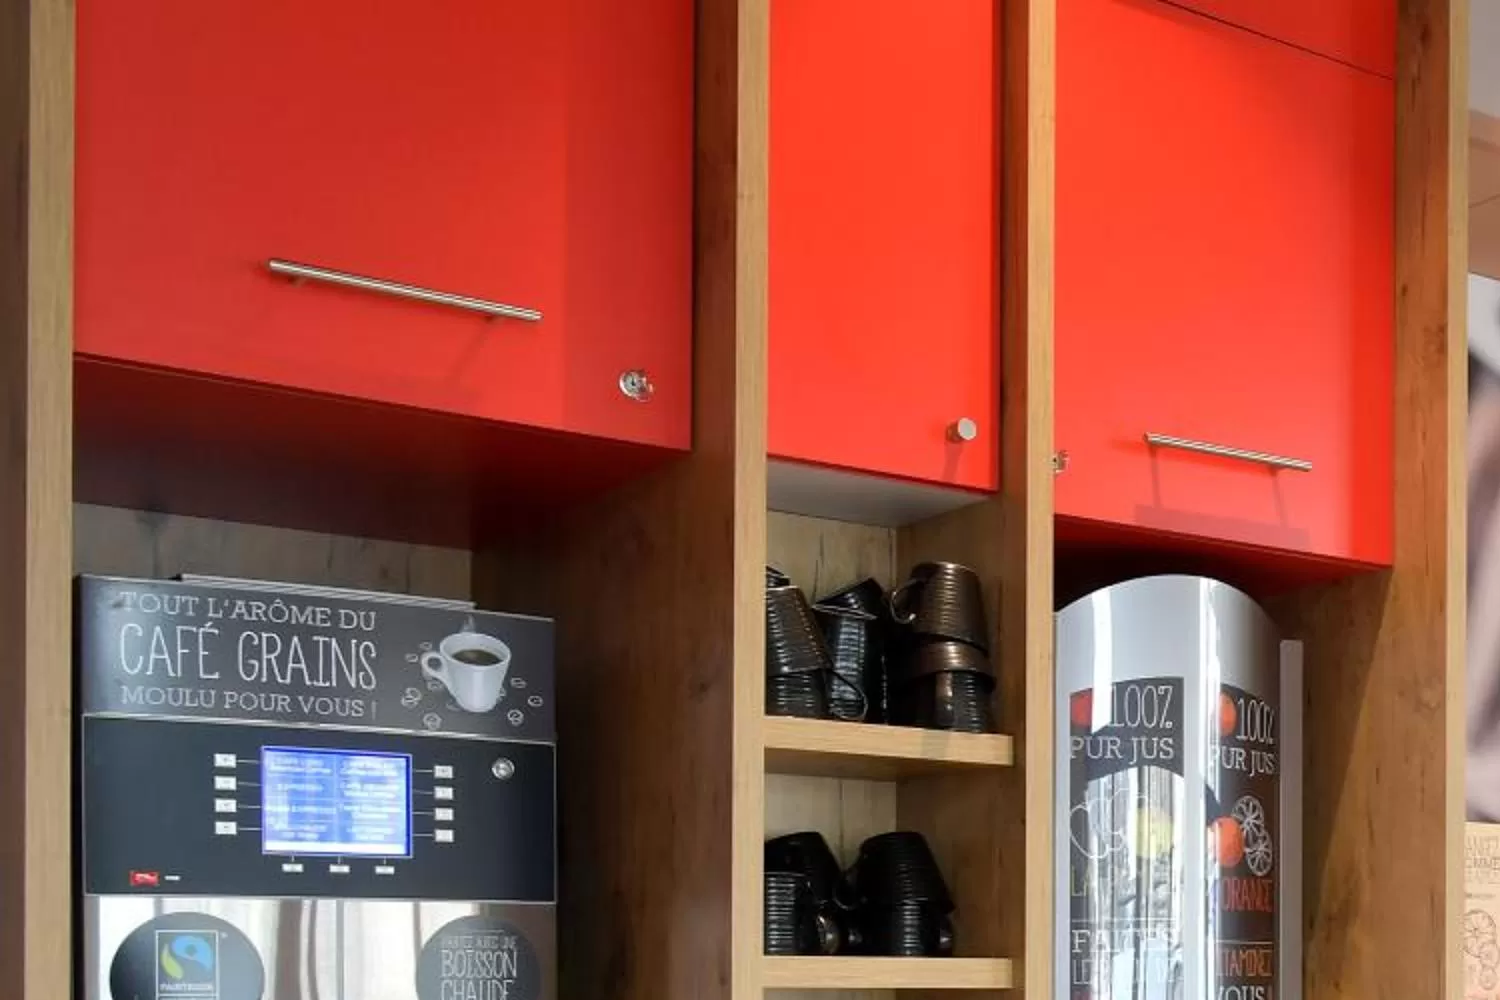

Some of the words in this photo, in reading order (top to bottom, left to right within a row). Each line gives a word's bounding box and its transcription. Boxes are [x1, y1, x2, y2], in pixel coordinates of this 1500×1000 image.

[120, 591, 199, 616] TOUT
[207, 597, 331, 628] L'ARÔME
[339, 608, 376, 631] DU
[120, 621, 220, 680] CAFÉ
[237, 630, 377, 690] GRAINS
[120, 685, 216, 708] MOULU
[223, 691, 291, 714] POUR
[298, 696, 365, 718] VOUS
[1069, 735, 1123, 760] PUR
[1128, 737, 1175, 765] JUS
[1249, 750, 1275, 777] JUS
[440, 949, 518, 978] BOISSON
